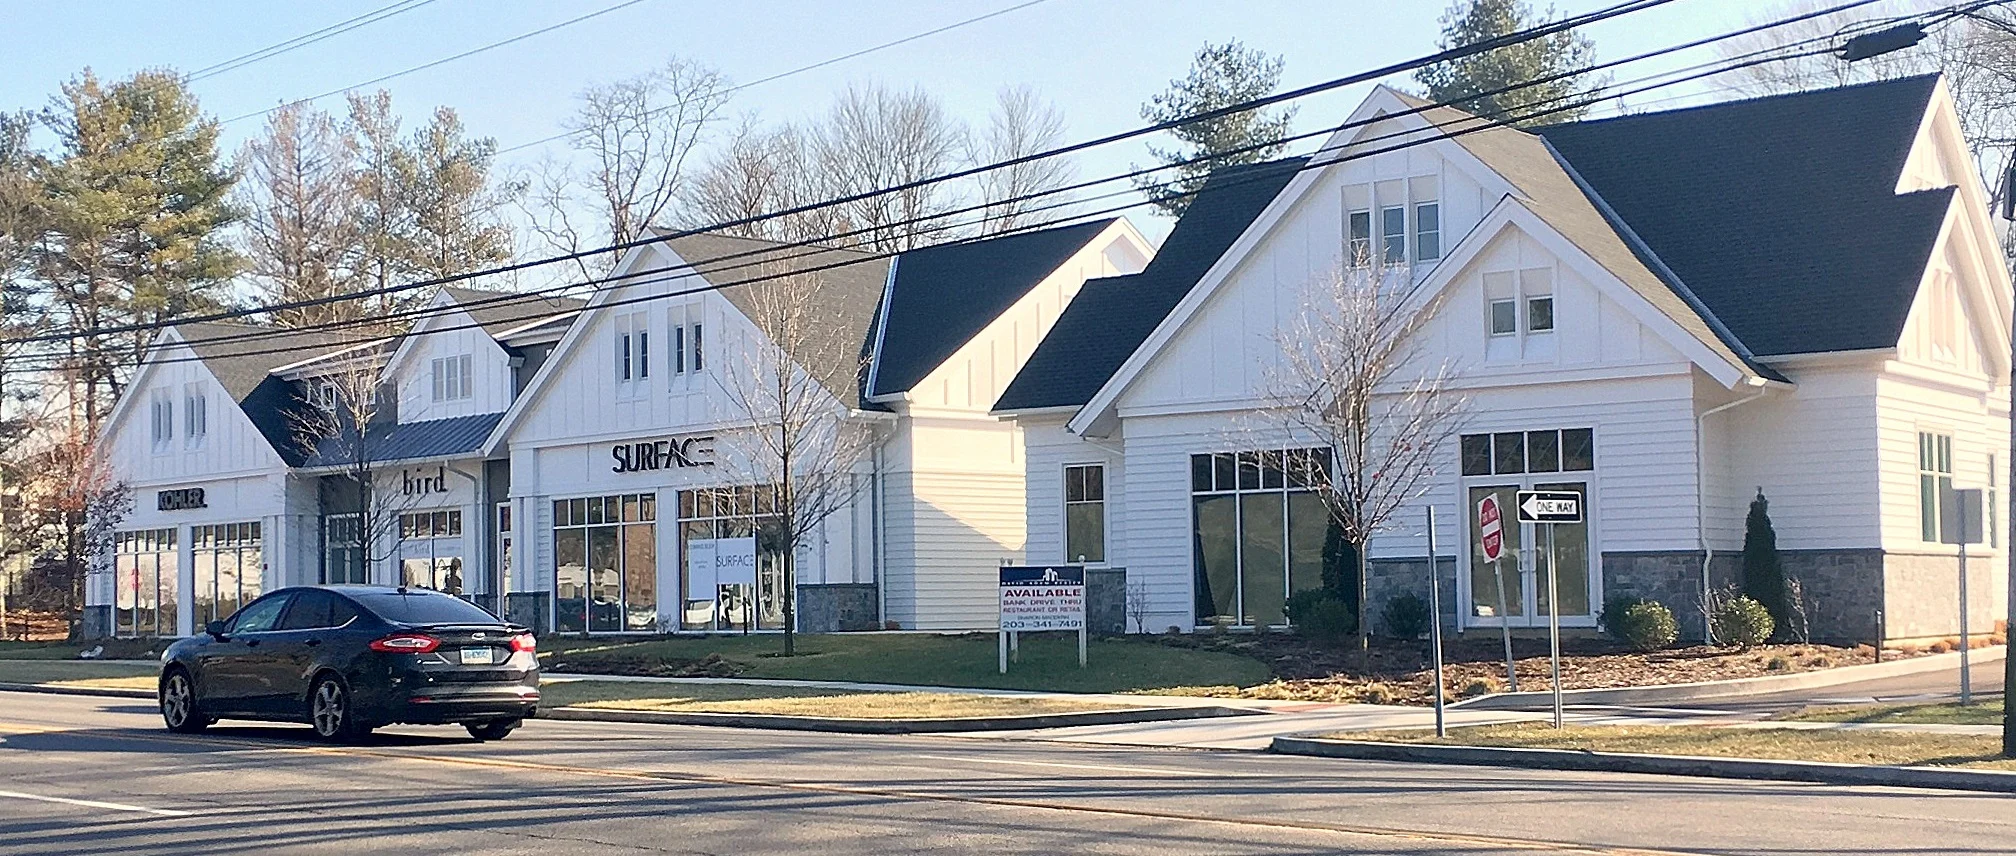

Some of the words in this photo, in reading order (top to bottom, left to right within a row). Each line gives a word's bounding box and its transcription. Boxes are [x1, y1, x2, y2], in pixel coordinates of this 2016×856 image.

[612, 436, 715, 474] SURFACE
[403, 466, 448, 496] bird
[1536, 501, 1554, 513] ONE
[1556, 501, 1575, 513] WAY
[715, 554, 754, 568] SURFACE
[1004, 588, 1082, 598] AVAILABLE
[1002, 620, 1082, 629] 203-341-7491
